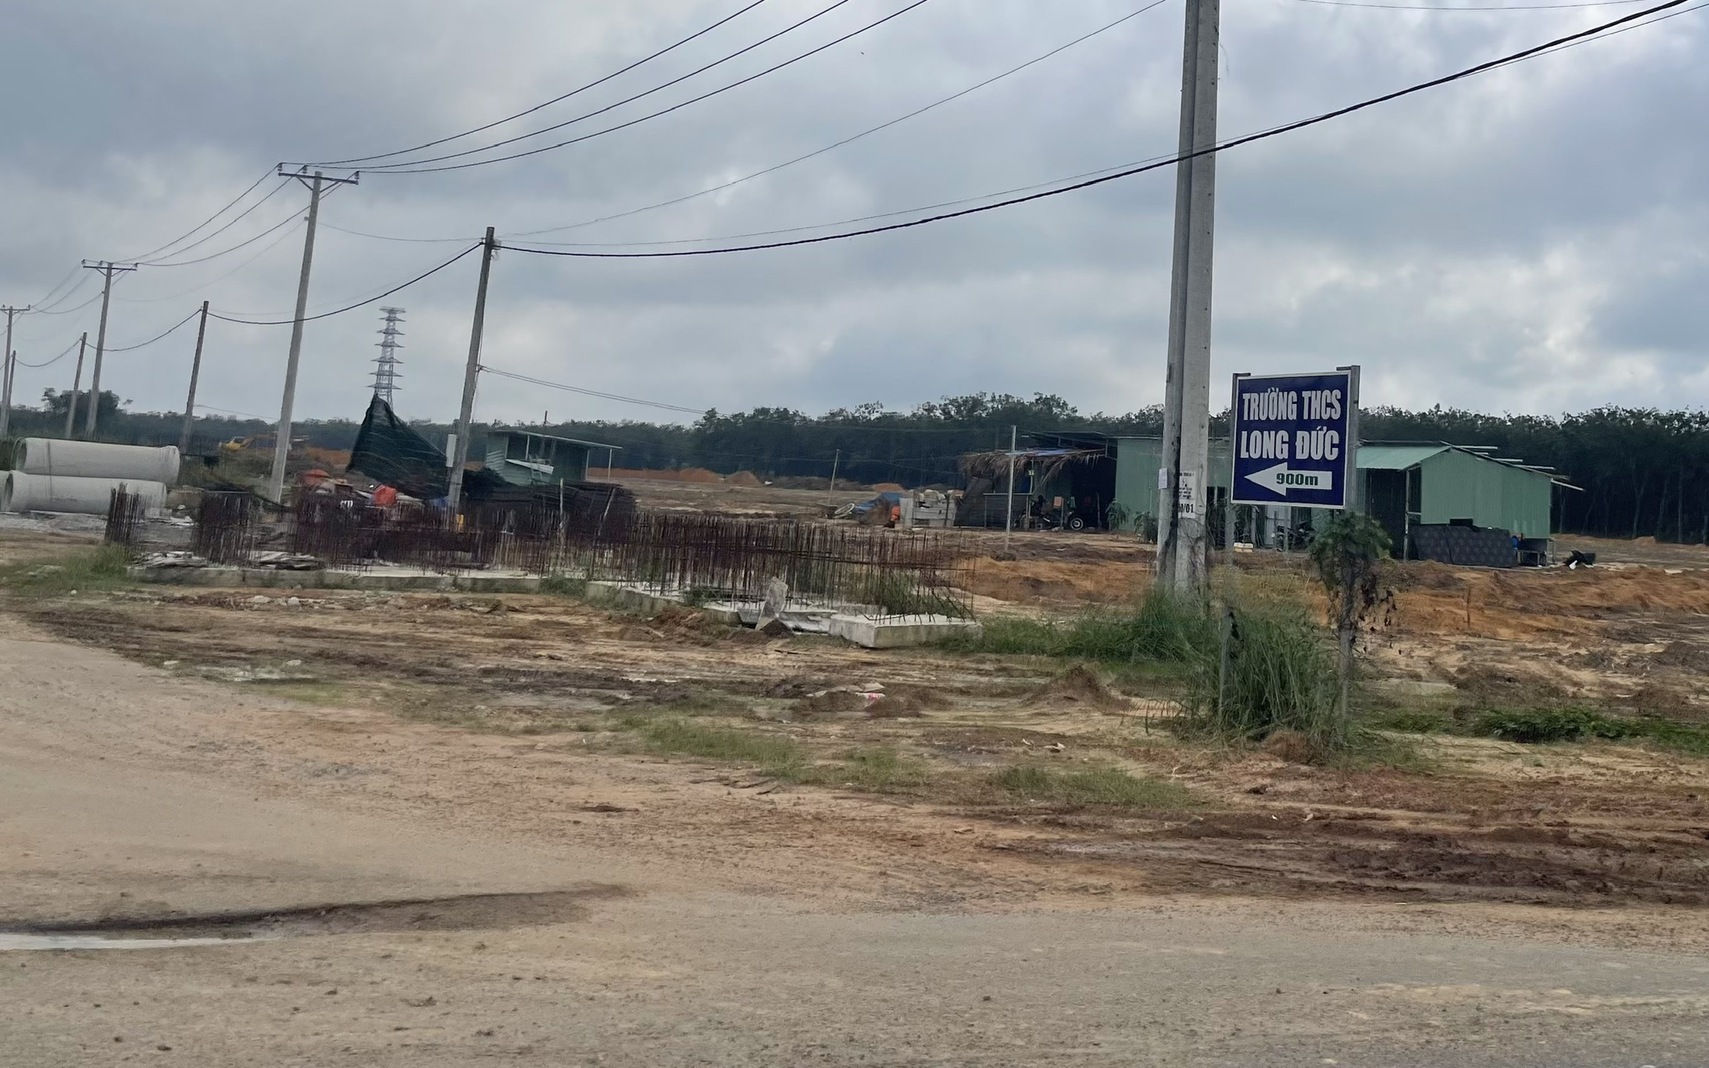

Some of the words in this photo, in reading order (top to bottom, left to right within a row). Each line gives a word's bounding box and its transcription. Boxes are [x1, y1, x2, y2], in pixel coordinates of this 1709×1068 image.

[1243, 387, 1297, 420] TRƯỜNG
[1302, 389, 1341, 420] THCS
[1240, 430, 1289, 459] LONG
[1295, 426, 1339, 460] ĐỨC
[1276, 473, 1318, 486] 900m
